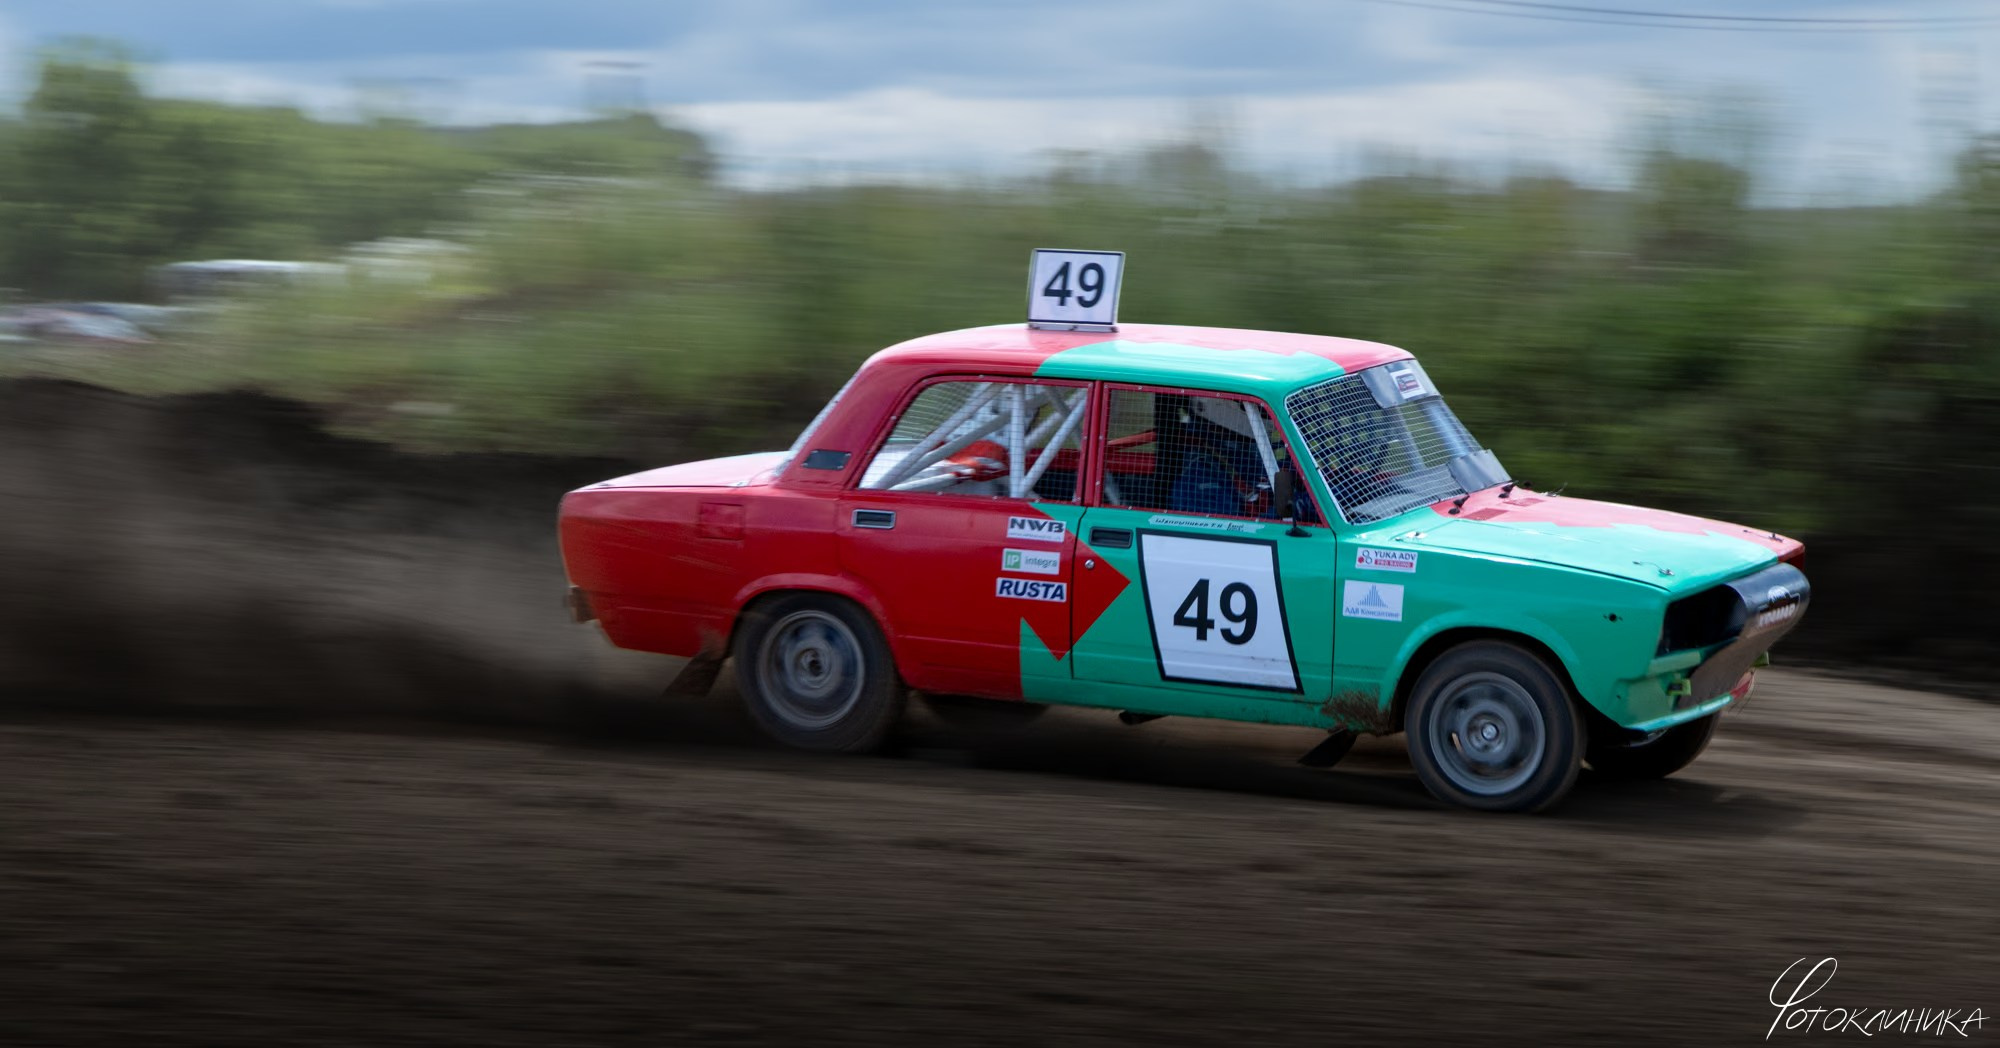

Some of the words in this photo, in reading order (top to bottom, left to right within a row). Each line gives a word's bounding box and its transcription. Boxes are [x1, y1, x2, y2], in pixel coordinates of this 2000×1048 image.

[1043, 261, 1106, 309] 49
[1009, 518, 1065, 533] NWB
[1025, 555, 1058, 569] integra
[1374, 550, 1398, 560] YUKA
[1399, 552, 1417, 561] ADV
[998, 579, 1065, 600] RUSTA
[1173, 578, 1258, 645] 49
